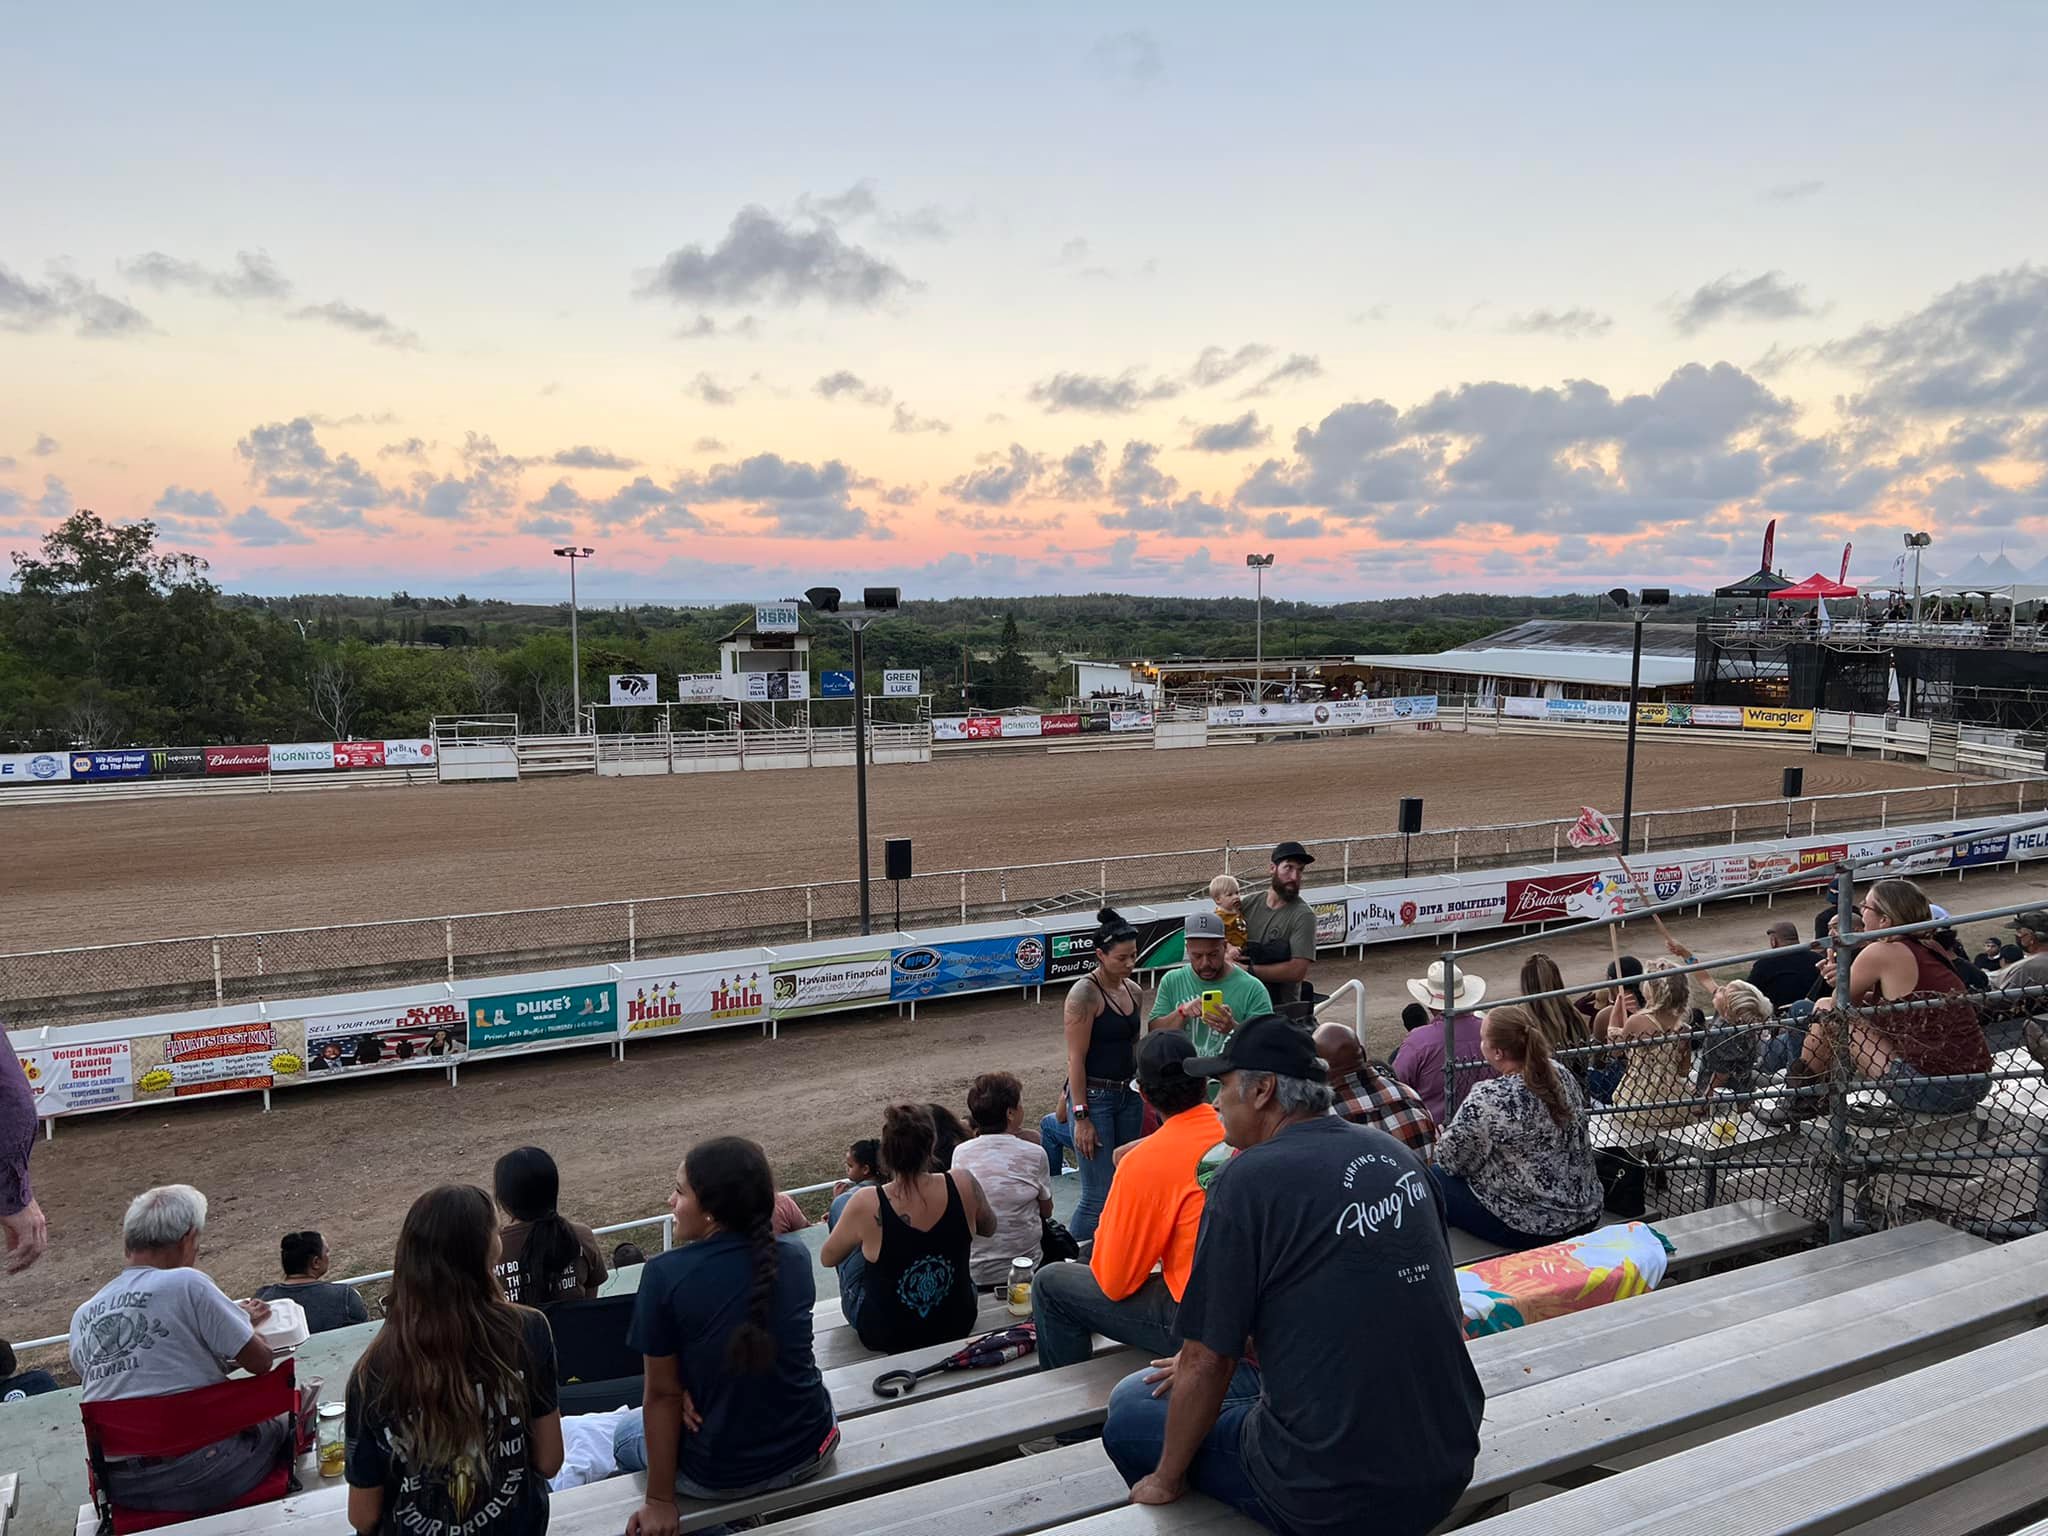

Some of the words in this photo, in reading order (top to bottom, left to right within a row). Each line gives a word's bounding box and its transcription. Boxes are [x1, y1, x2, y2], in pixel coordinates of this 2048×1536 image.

[758, 612, 797, 623] HSRN
[886, 672, 919, 682] GREEN
[890, 685, 913, 693] LUKE
[1748, 709, 1804, 726] Wrangler
[1003, 721, 1040, 730] HORNITOS
[1041, 719, 1079, 730] Budweiser
[95, 755, 106, 763] We
[106, 756, 122, 765] Keep
[124, 754, 145, 762] Hawaii
[207, 754, 270, 767] Budweiser
[272, 751, 331, 762] HORNITOS
[122, 762, 142, 770] Move!
[1801, 854, 1815, 864] CITY
[1815, 851, 1829, 863] MILL
[1655, 870, 1682, 881] COUNTRY
[1419, 903, 1443, 916] DITA
[1447, 896, 1506, 912] HOLIFIELD'S
[1350, 908, 1369, 932] JIM
[1369, 903, 1396, 925] BEAM
[1434, 913, 1465, 924] ALL-AMERICAN
[1466, 911, 1482, 920] EVENTS
[904, 953, 932, 968] MPS
[1050, 961, 1081, 974] Proud
[798, 973, 844, 986] Hawaiian
[845, 966, 888, 980] Financial
[824, 981, 845, 991] Credit
[516, 995, 571, 1016] DUKE'S
[711, 987, 763, 1012] Hula
[407, 1004, 455, 1018] $5,000
[627, 996, 682, 1022] Hula
[307, 1024, 333, 1034] SELL
[336, 1021, 364, 1031] YOUR
[364, 1017, 395, 1027] HOME
[395, 1014, 431, 1028] FLAT
[436, 1011, 465, 1024] FEE!
[484, 1032, 507, 1041] Prime
[508, 1030, 522, 1038] Rib
[523, 1028, 545, 1036] Buffet
[163, 1034, 216, 1060] HAWAII'S
[216, 1032, 247, 1047] BEST
[247, 1028, 278, 1047] KINE
[52, 1048, 83, 1060] Voted
[85, 1043, 129, 1057] Hawaii's
[70, 1056, 112, 1069] Favorite
[225, 1056, 245, 1065] Teriyaki
[245, 1054, 267, 1062] Chicken
[71, 1066, 112, 1080] Burger!
[180, 1062, 201, 1071] Teriyaki
[225, 1064, 246, 1072] Teriyaki
[181, 1070, 201, 1078] Teriyaki
[58, 1081, 90, 1091] LOCATIONS
[90, 1076, 125, 1088] ISLANDWIDE
[1343, 1154, 1376, 1189] SURFING
[1335, 1192, 1404, 1237] Hang
[1395, 1170, 1427, 1208] Ten
[1398, 1268, 1414, 1278] EST.
[78, 1300, 106, 1336] HANG
[109, 1292, 153, 1310] LOOSE
[88, 1356, 140, 1381] HAWAII
[396, 1502, 443, 1536] YOUR
[449, 1467, 525, 1536] PROBLEM
